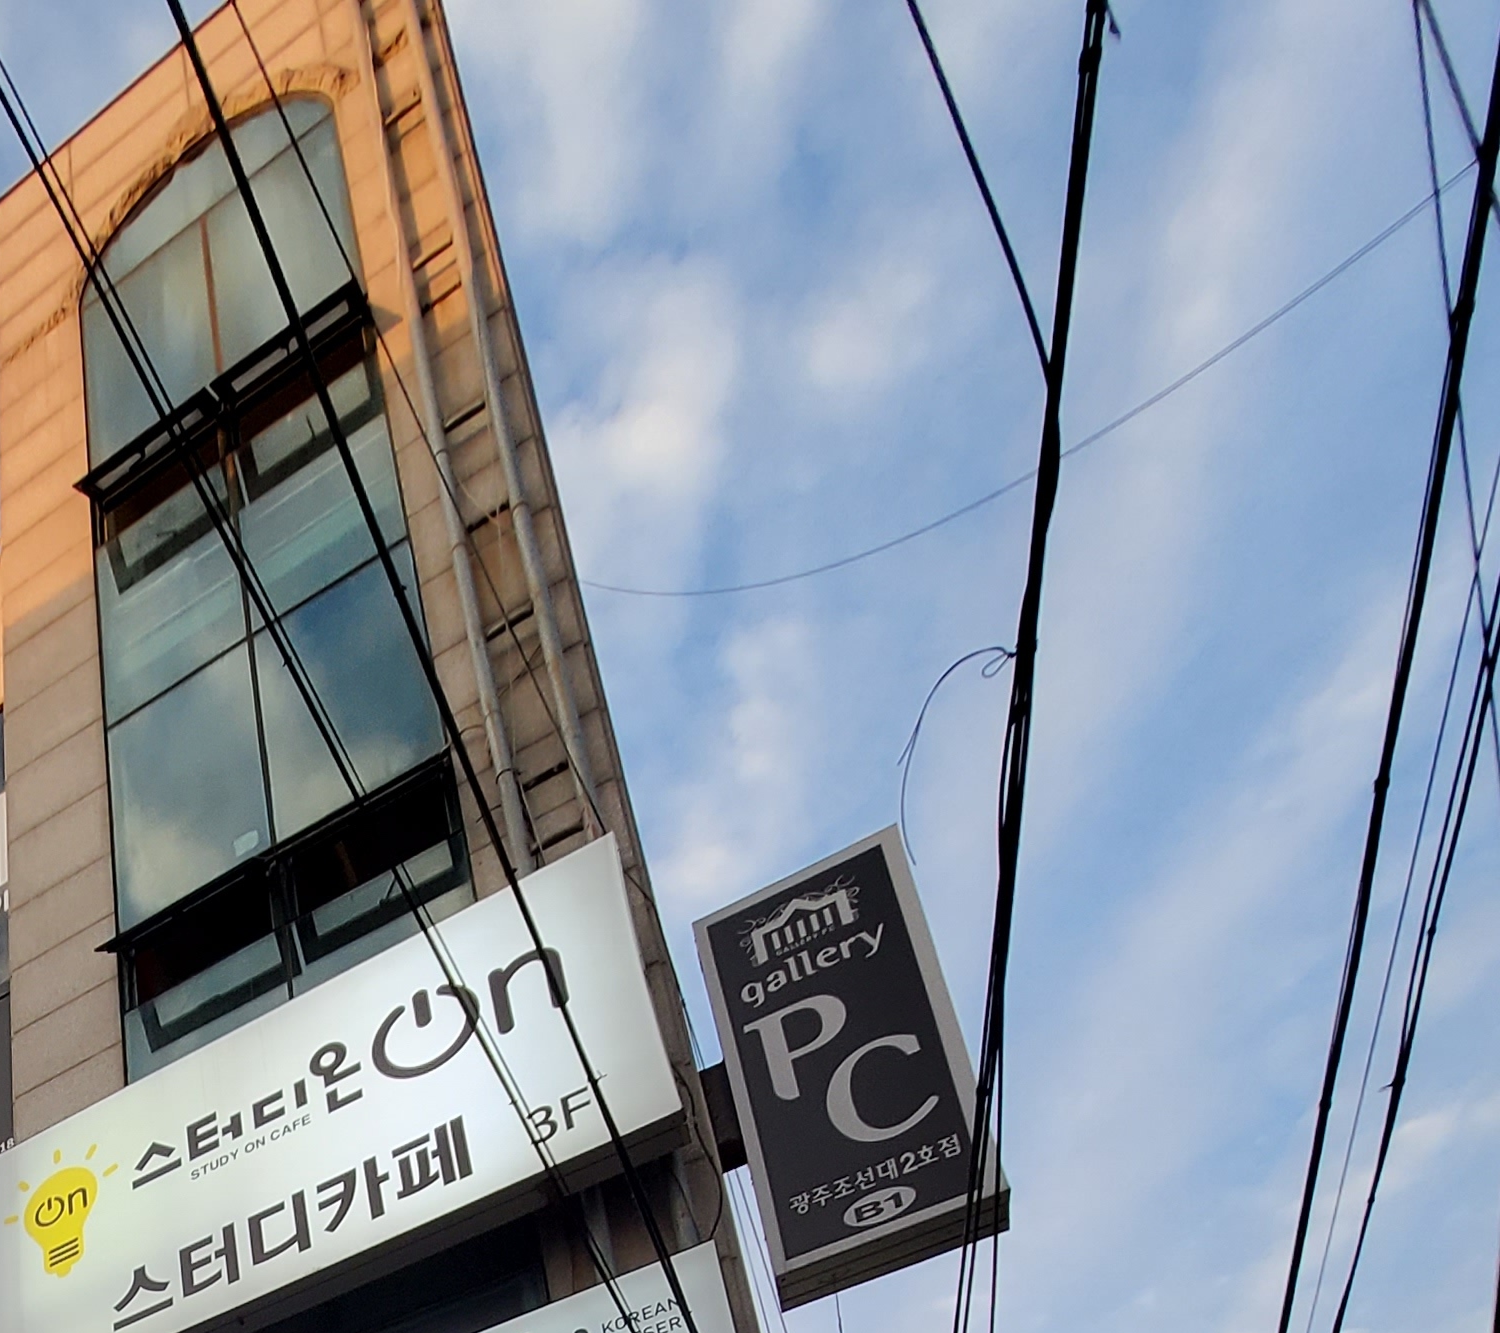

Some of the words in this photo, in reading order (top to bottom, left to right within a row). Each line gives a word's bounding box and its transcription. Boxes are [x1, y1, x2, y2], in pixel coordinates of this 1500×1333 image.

[740, 922, 884, 1008] gallery
[131, 1041, 363, 1191] 스터디온
[371, 946, 570, 1080] On
[742, 994, 940, 1143] PC
[190, 1151, 240, 1181] STUDY
[244, 1136, 275, 1160] ON
[278, 1113, 312, 1143] CAFE
[528, 1085, 592, 1145] 3F
[33, 1186, 88, 1228] On
[788, 1133, 963, 1217] 광주조선대2호점
[853, 1196, 904, 1223] B1
[112, 1115, 473, 1332] 스터디카페
